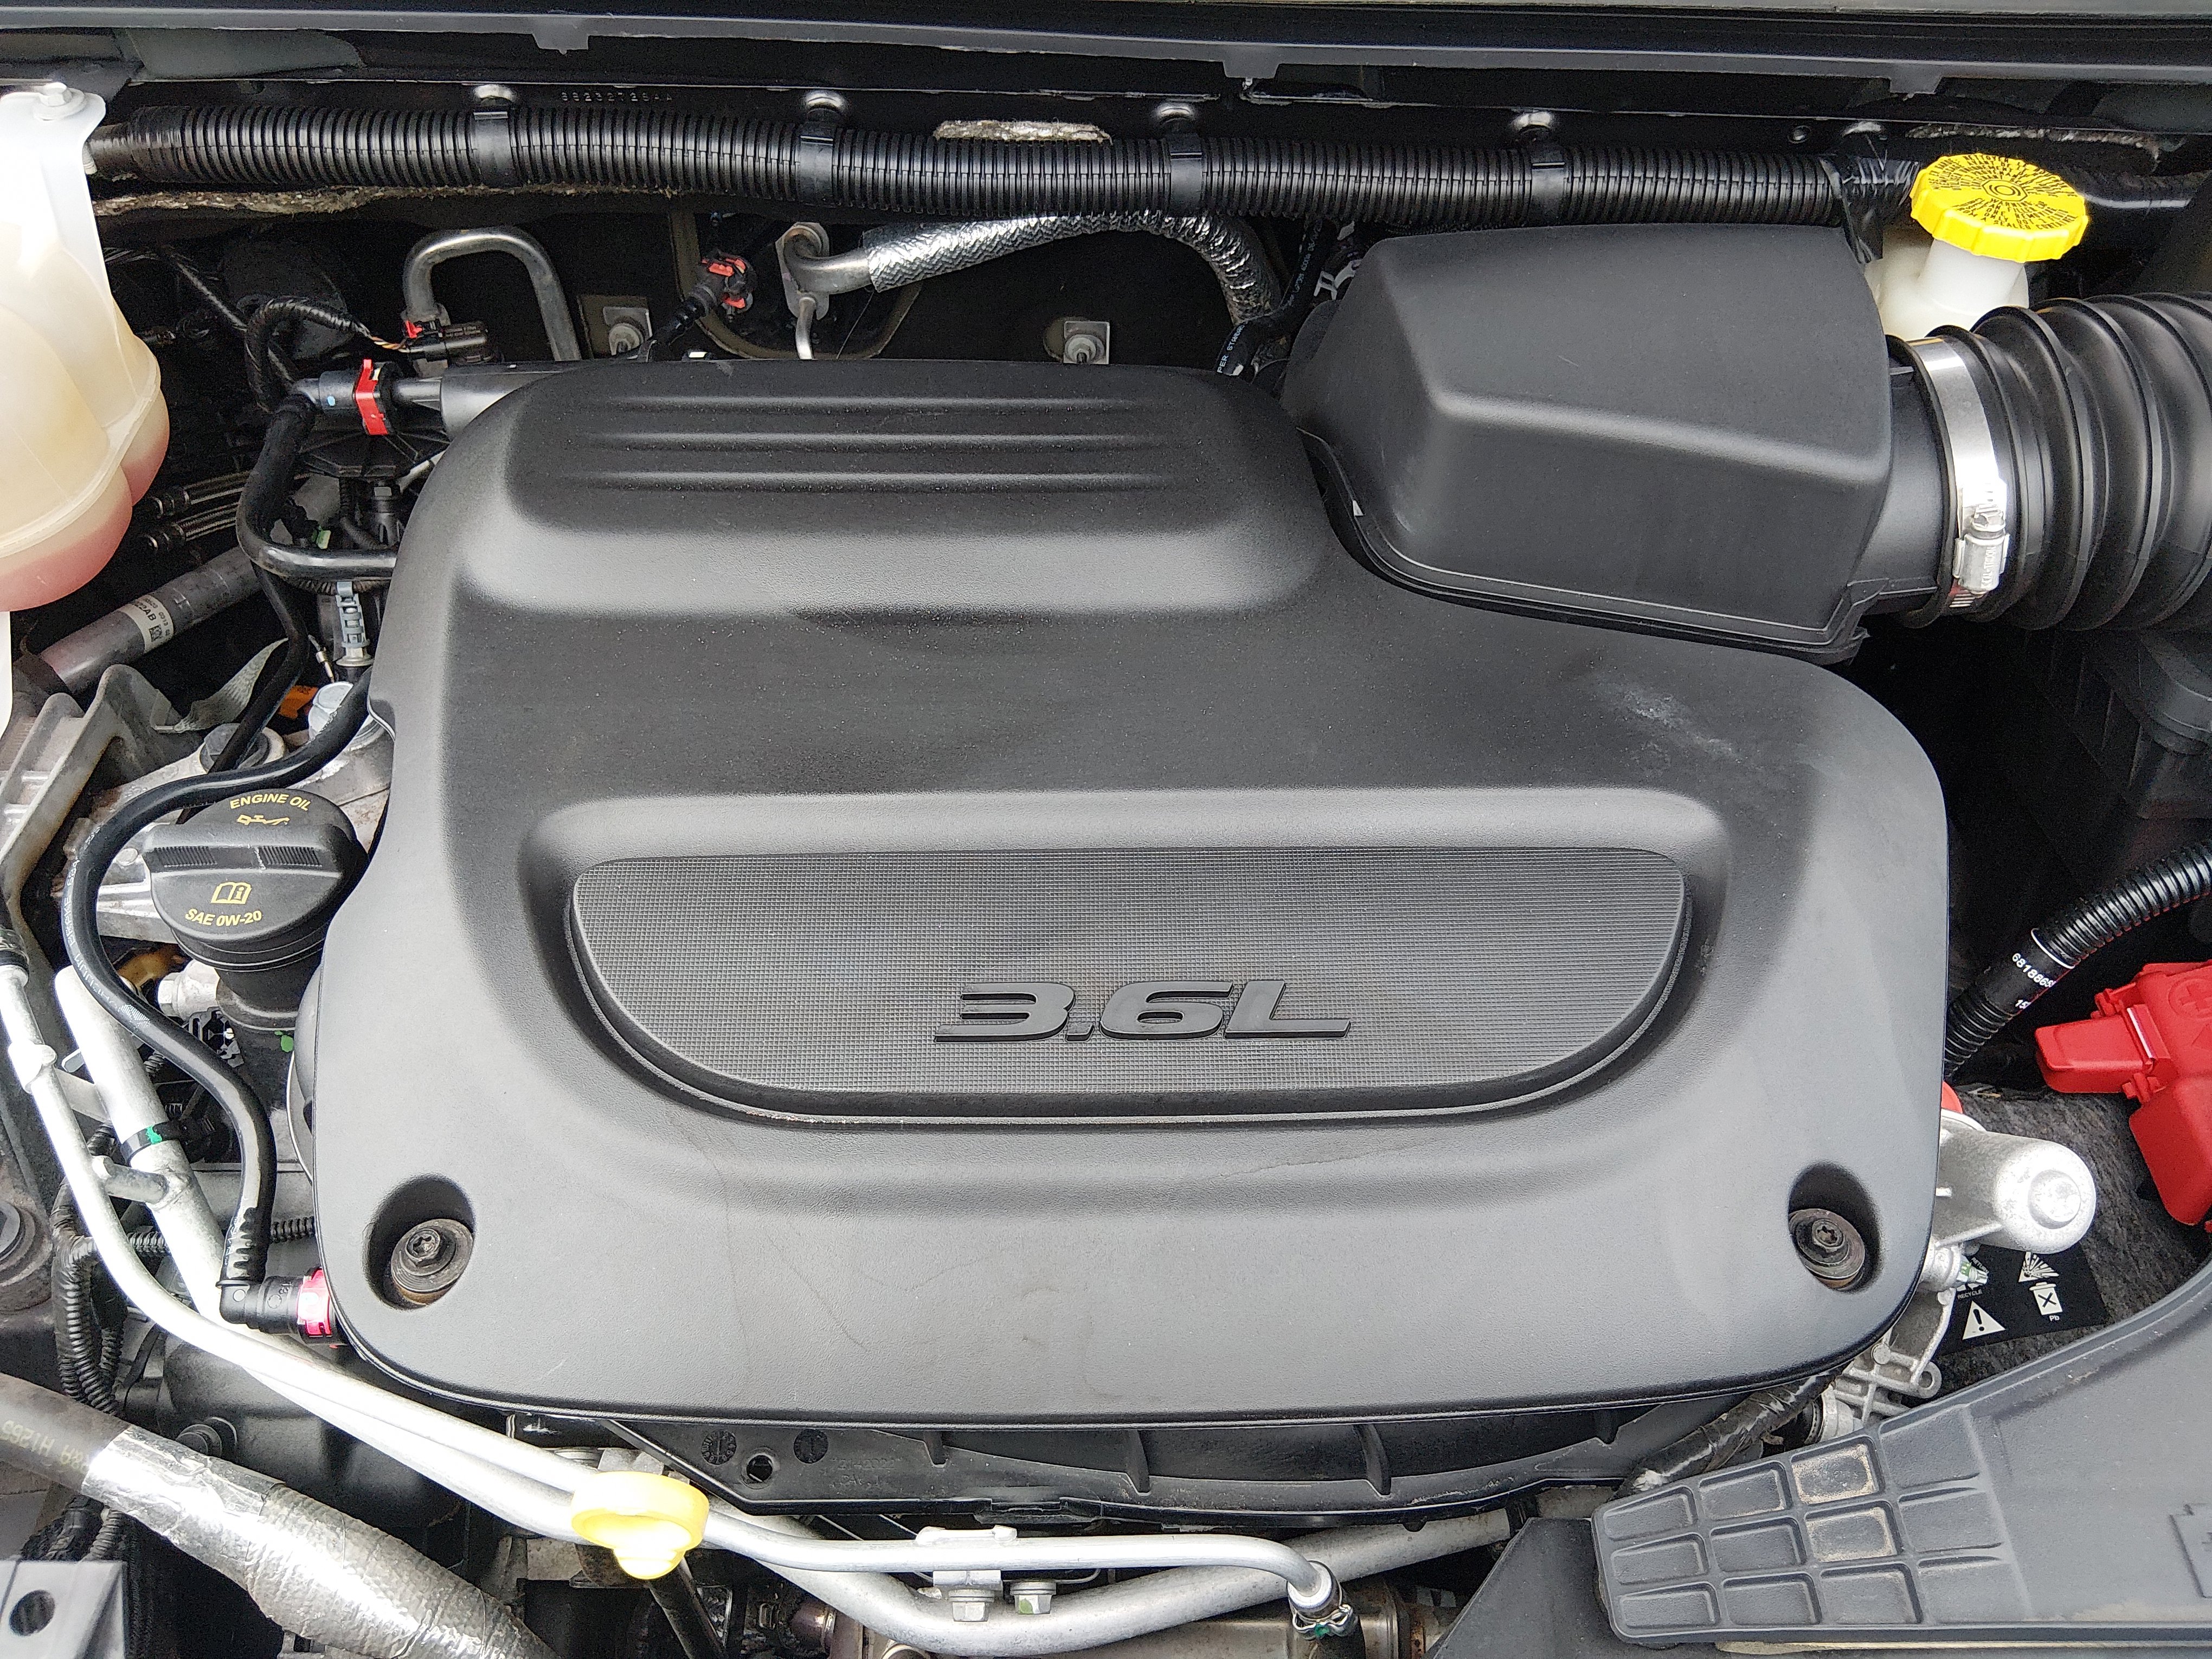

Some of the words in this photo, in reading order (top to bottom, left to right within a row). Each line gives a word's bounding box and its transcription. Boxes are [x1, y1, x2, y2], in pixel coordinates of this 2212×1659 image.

[230, 794, 289, 809] ENGINE
[290, 796, 311, 811] OIL
[185, 908, 216, 925] SAE
[216, 910, 262, 926] 0W-20
[935, 980, 1351, 1041] 3.6L
[1957, 1289, 1982, 1300] RECYCLE
